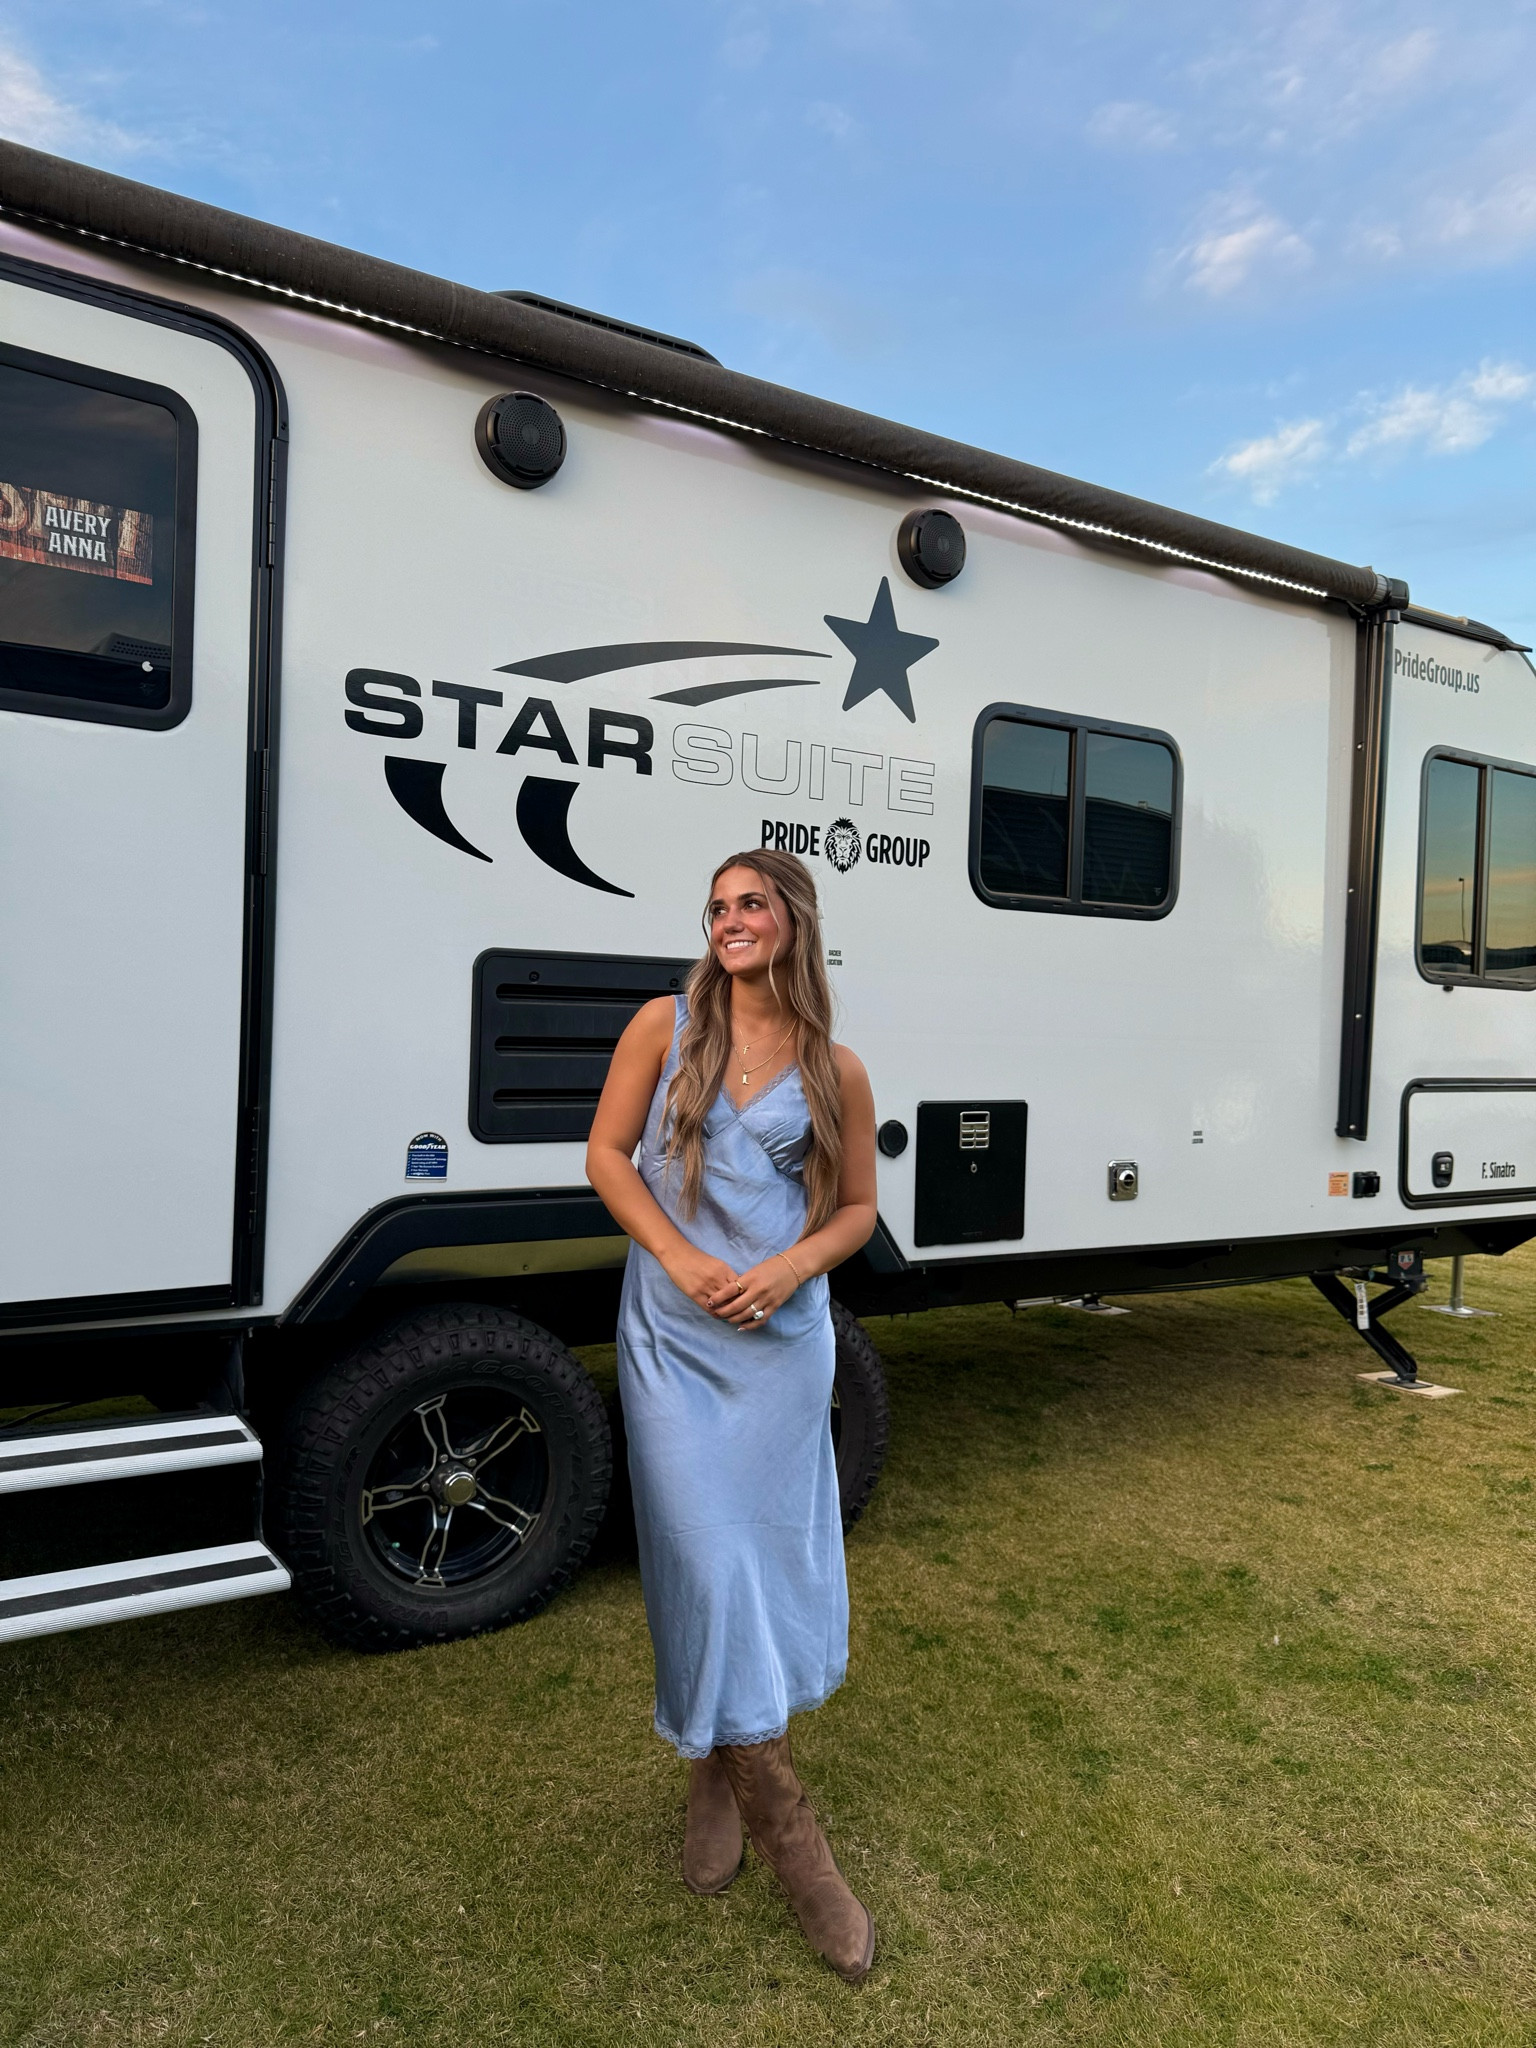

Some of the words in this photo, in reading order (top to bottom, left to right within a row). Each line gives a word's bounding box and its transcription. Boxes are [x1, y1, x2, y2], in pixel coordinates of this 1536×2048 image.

[45, 505, 111, 538] AVERY
[48, 532, 107, 563] ANNA
[1393, 648, 1480, 693] PrideGroup.us
[345, 668, 655, 776] STAR
[672, 723, 936, 815] SUITE
[761, 819, 820, 856] PRIDE
[866, 833, 930, 868] GROUP
[1481, 1162, 1488, 1179] F.
[1489, 1161, 1516, 1179] Sinatra
